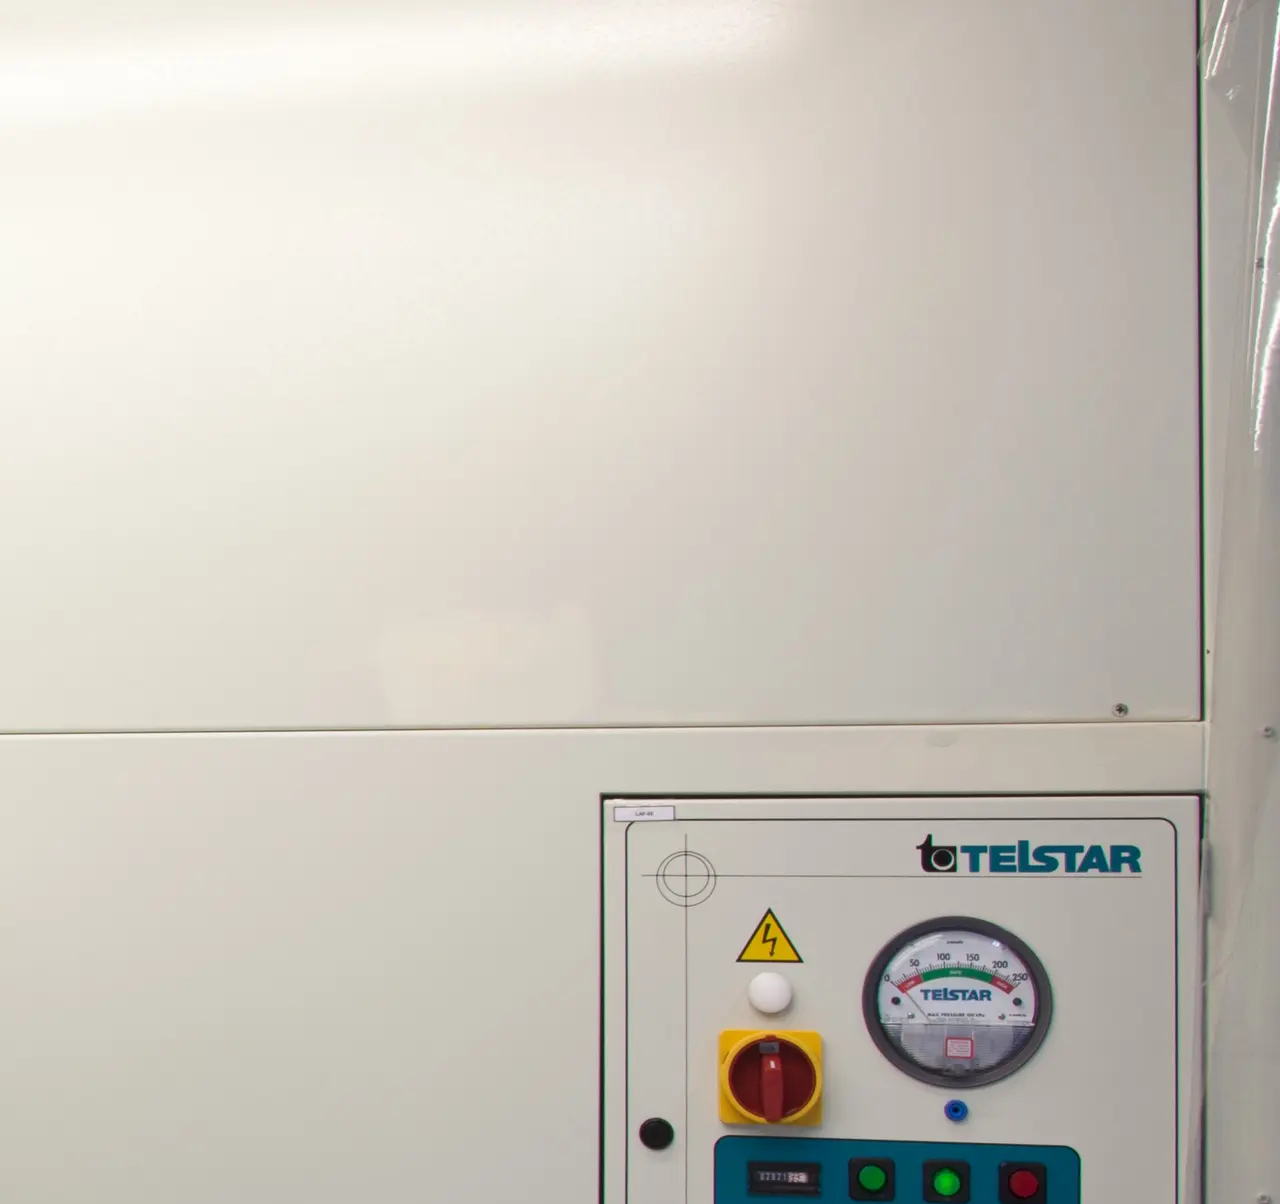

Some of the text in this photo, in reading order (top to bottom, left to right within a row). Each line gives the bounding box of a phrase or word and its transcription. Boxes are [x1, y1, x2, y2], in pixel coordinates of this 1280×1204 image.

[960, 840, 1142, 873] TELSTAR
[936, 953, 951, 961] 100
[966, 953, 980, 961] 150
[909, 959, 920, 967] 50
[992, 961, 1008, 969] 200
[1012, 973, 1028, 981] 250
[920, 987, 992, 1001] TELSTAR
